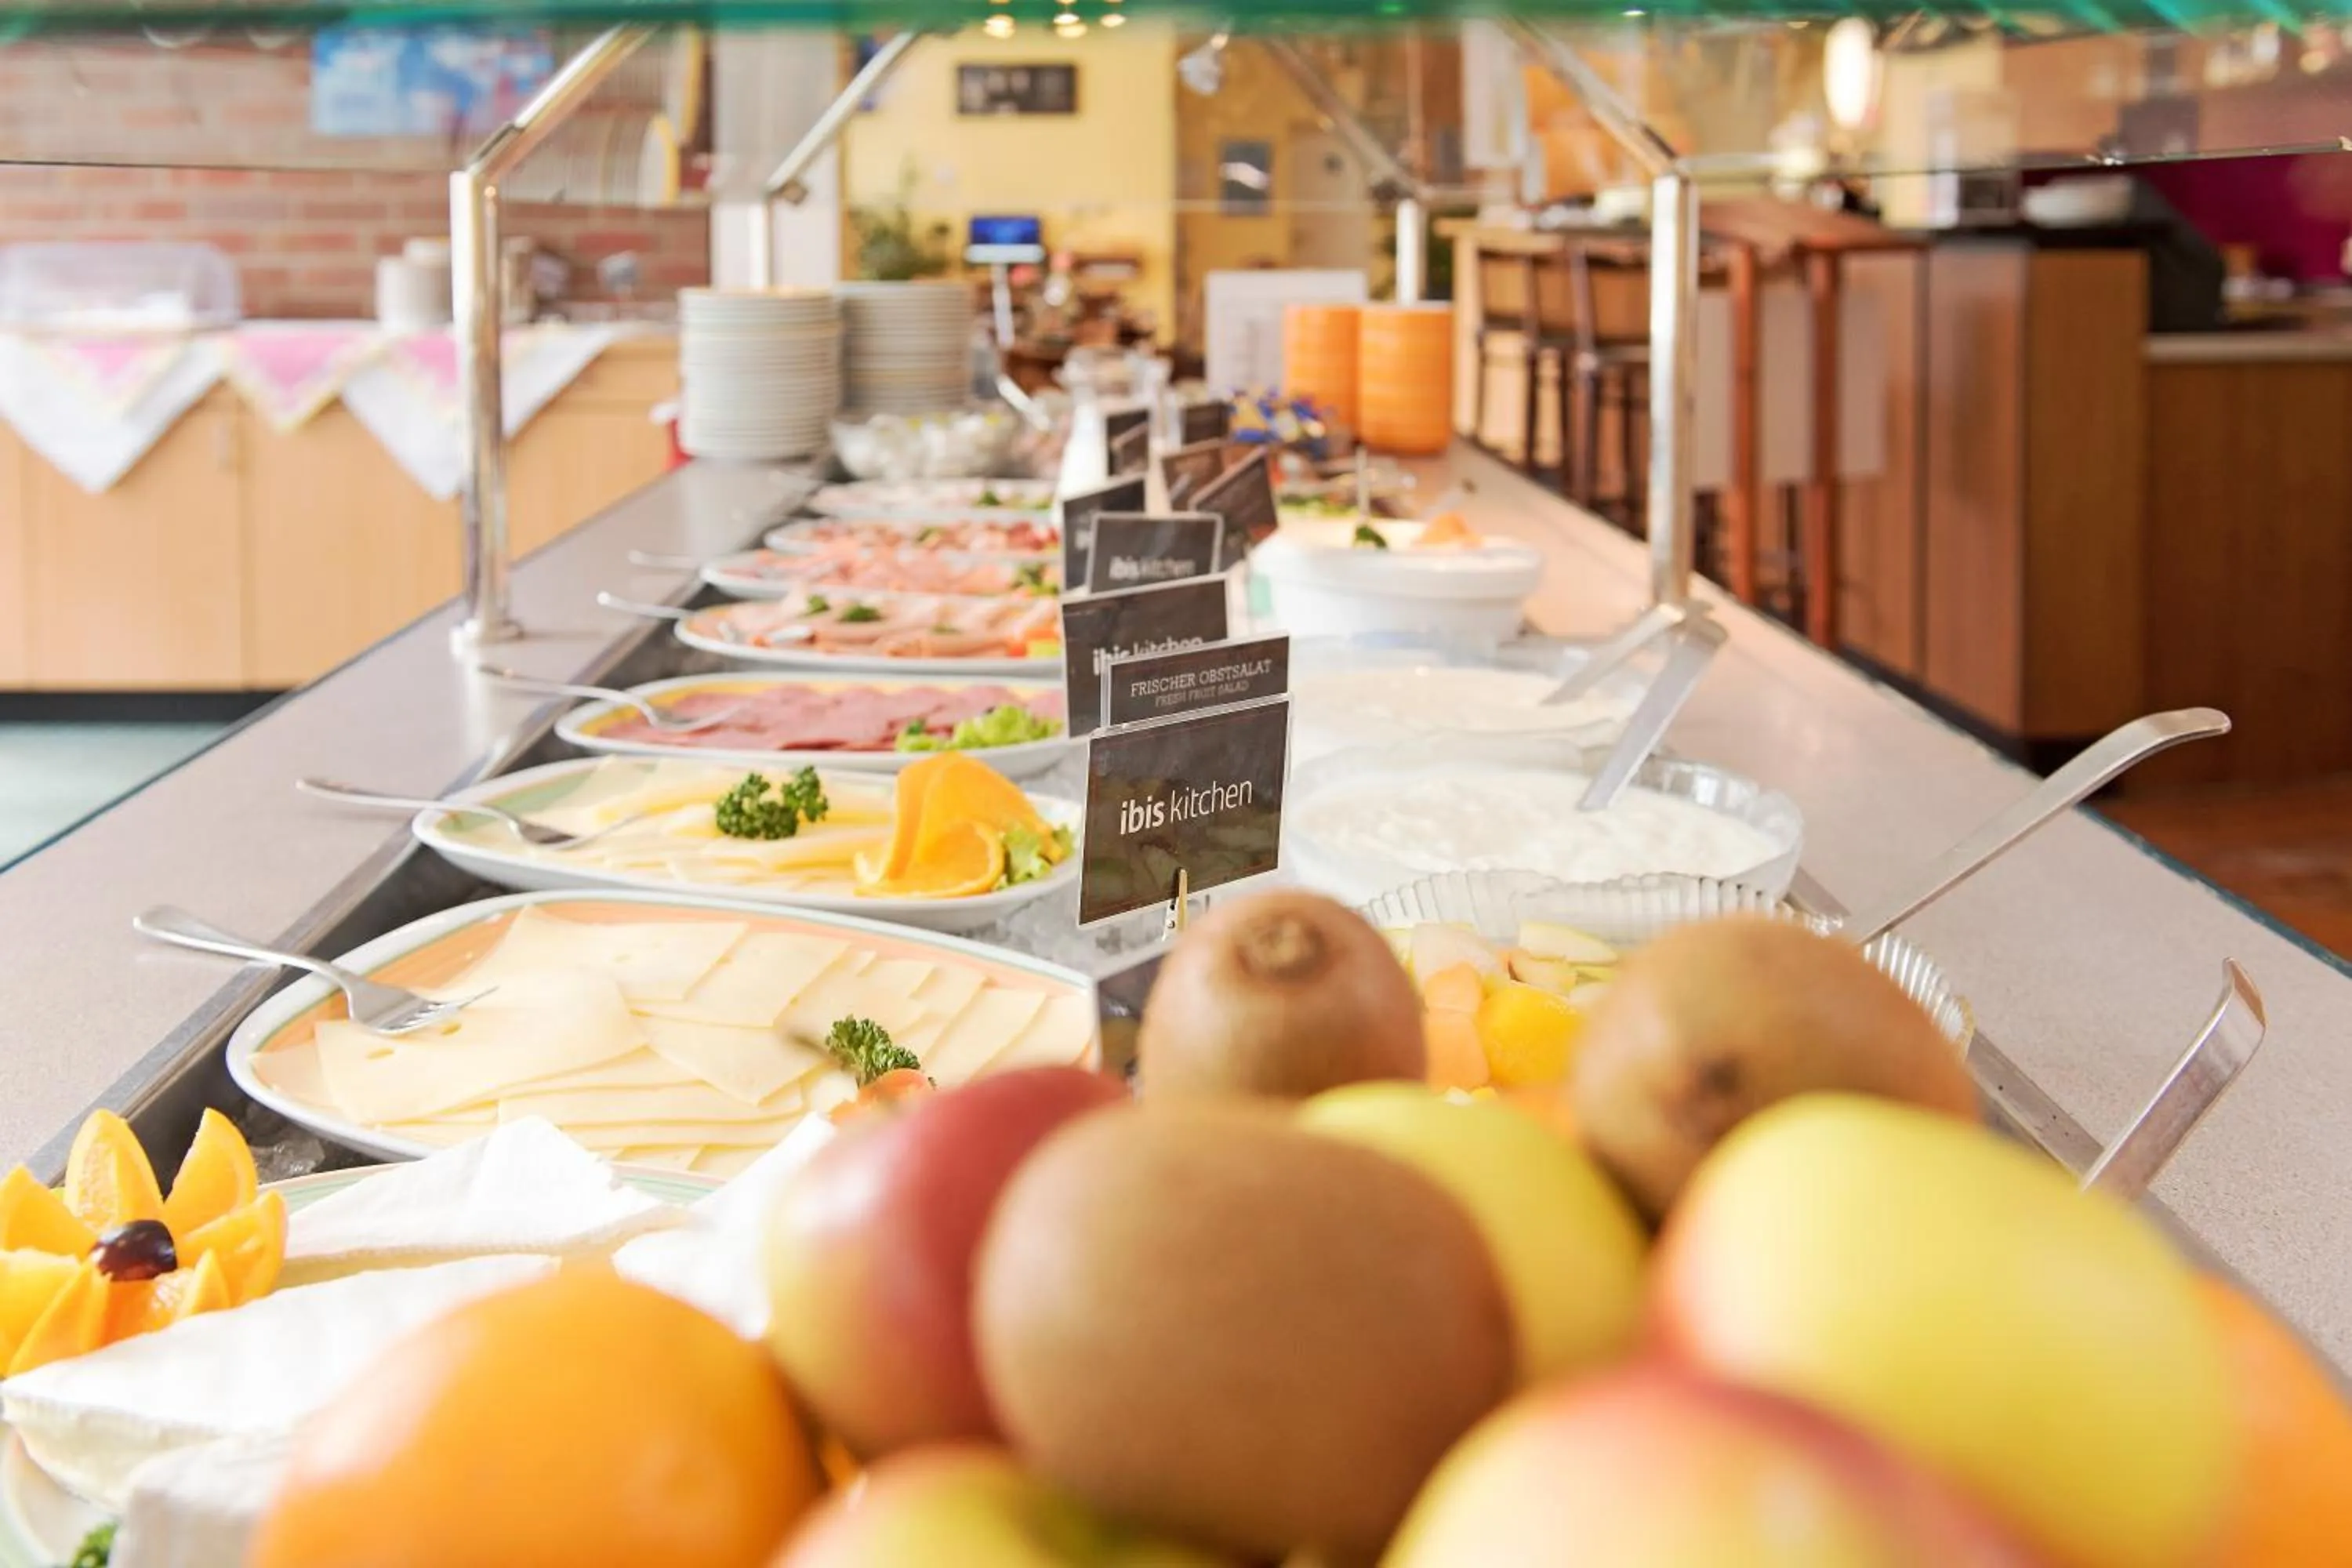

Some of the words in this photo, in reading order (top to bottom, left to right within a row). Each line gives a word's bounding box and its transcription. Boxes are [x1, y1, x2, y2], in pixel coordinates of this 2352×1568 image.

[1131, 673, 1196, 697] FRISCHER
[1199, 659, 1272, 684] OBSTSALAT
[1155, 689, 1187, 707] FRESH
[1189, 686, 1215, 702] FRUIT
[1218, 680, 1250, 698] SALAD
[1120, 795, 1166, 836] ibis
[1170, 779, 1253, 823] kitchen
